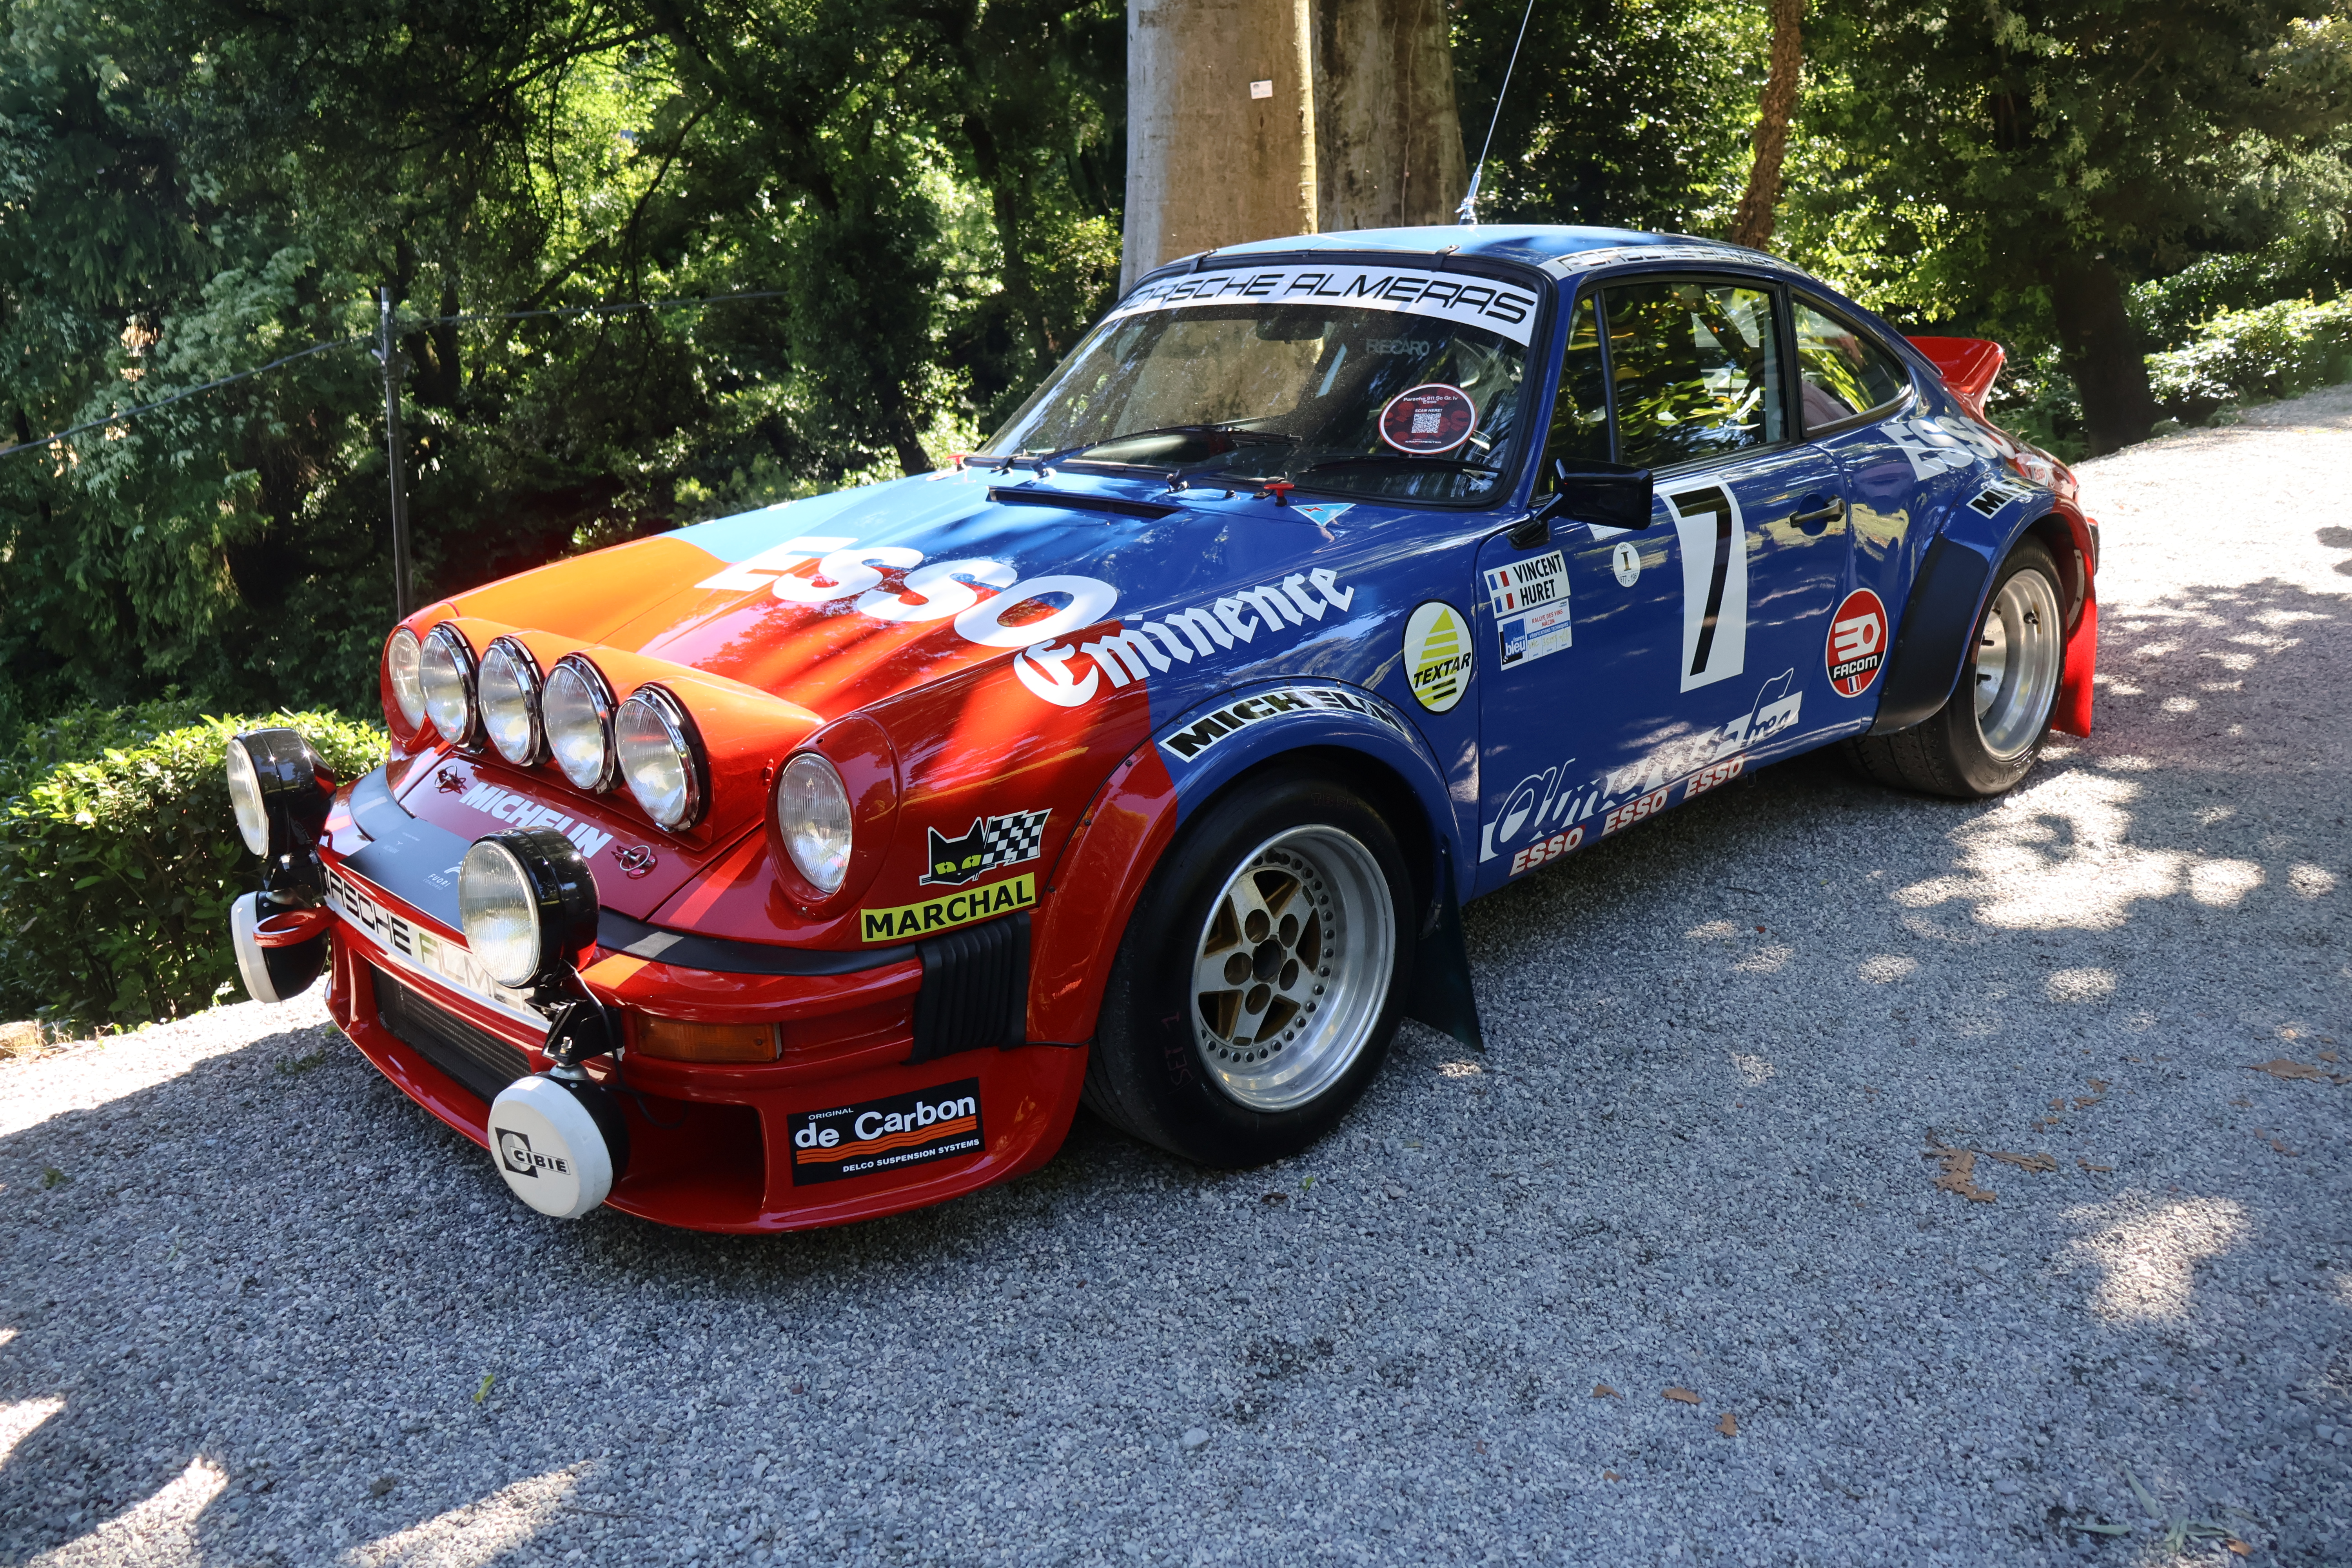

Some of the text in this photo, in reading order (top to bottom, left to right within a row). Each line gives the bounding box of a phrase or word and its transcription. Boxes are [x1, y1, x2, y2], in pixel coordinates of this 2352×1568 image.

[1283, 273, 1535, 325] ALMERAS
[1366, 338, 1430, 356] RECARO
[1878, 416, 2016, 482] ESSO
[1513, 554, 1562, 583] VINCENT
[1670, 486, 1731, 676] 7
[694, 536, 1117, 647] ESSO
[1520, 579, 1555, 606] HURET
[1014, 568, 1354, 707] Eminence
[1532, 615, 1545, 623] RALLYE
[1505, 640, 1526, 656] bleu
[1833, 655, 1877, 679] FACOM
[1414, 652, 1471, 689] TEXTAR
[1166, 690, 1412, 757] MICHELIN
[1683, 755, 1744, 799] ESSO
[1601, 789, 1668, 837] ESSO
[1509, 827, 1583, 877] ESSO
[428, 873, 451, 887] FUORI
[866, 881, 1032, 938] MARCHAL
[795, 1097, 975, 1148] de Carbon
[808, 1108, 854, 1120] ORIGINAL
[843, 1138, 980, 1172] DELCO SUSPENSION SYSTEMS
